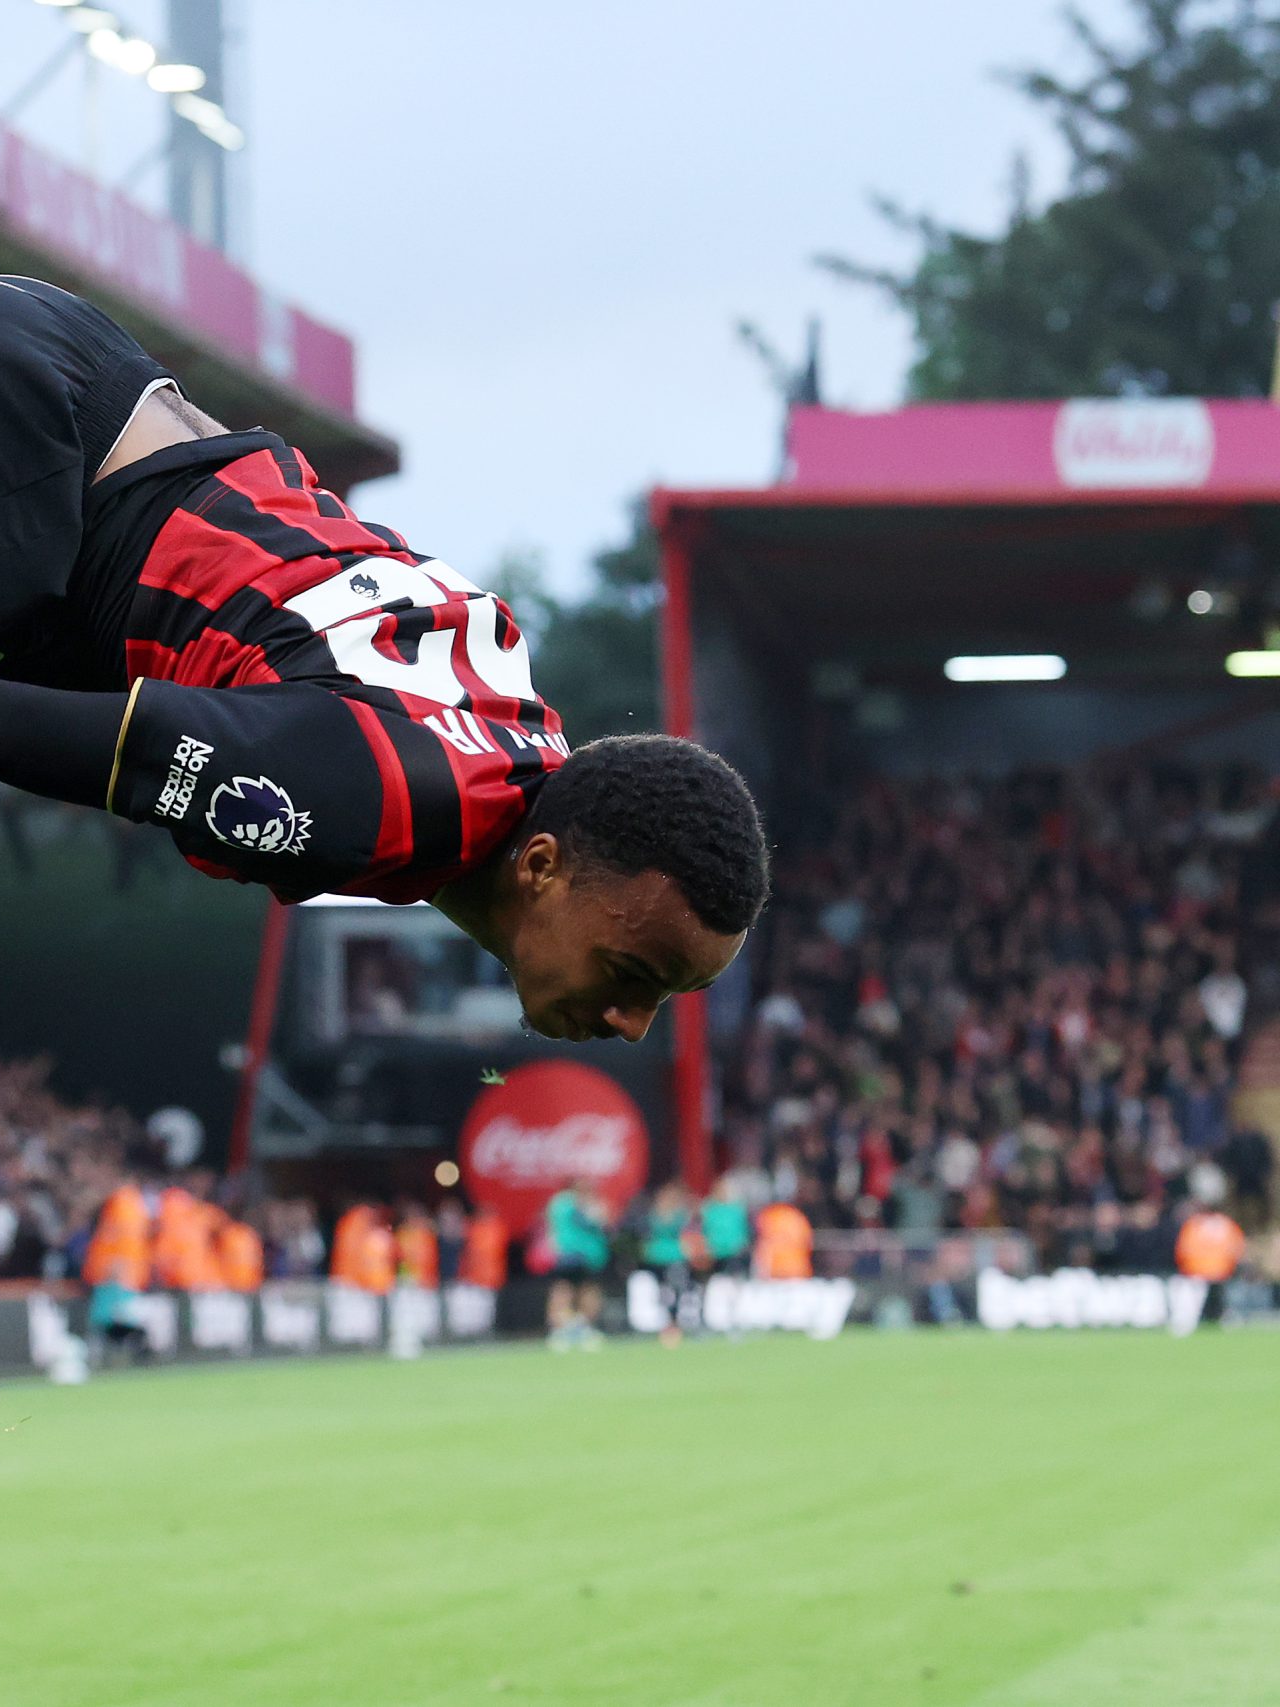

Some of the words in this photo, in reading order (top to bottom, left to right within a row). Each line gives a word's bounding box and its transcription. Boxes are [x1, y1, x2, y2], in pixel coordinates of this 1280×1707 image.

[282, 556, 536, 707] 22
[192, 740, 214, 772] No
[154, 764, 184, 816] racism
[169, 772, 198, 819] room
